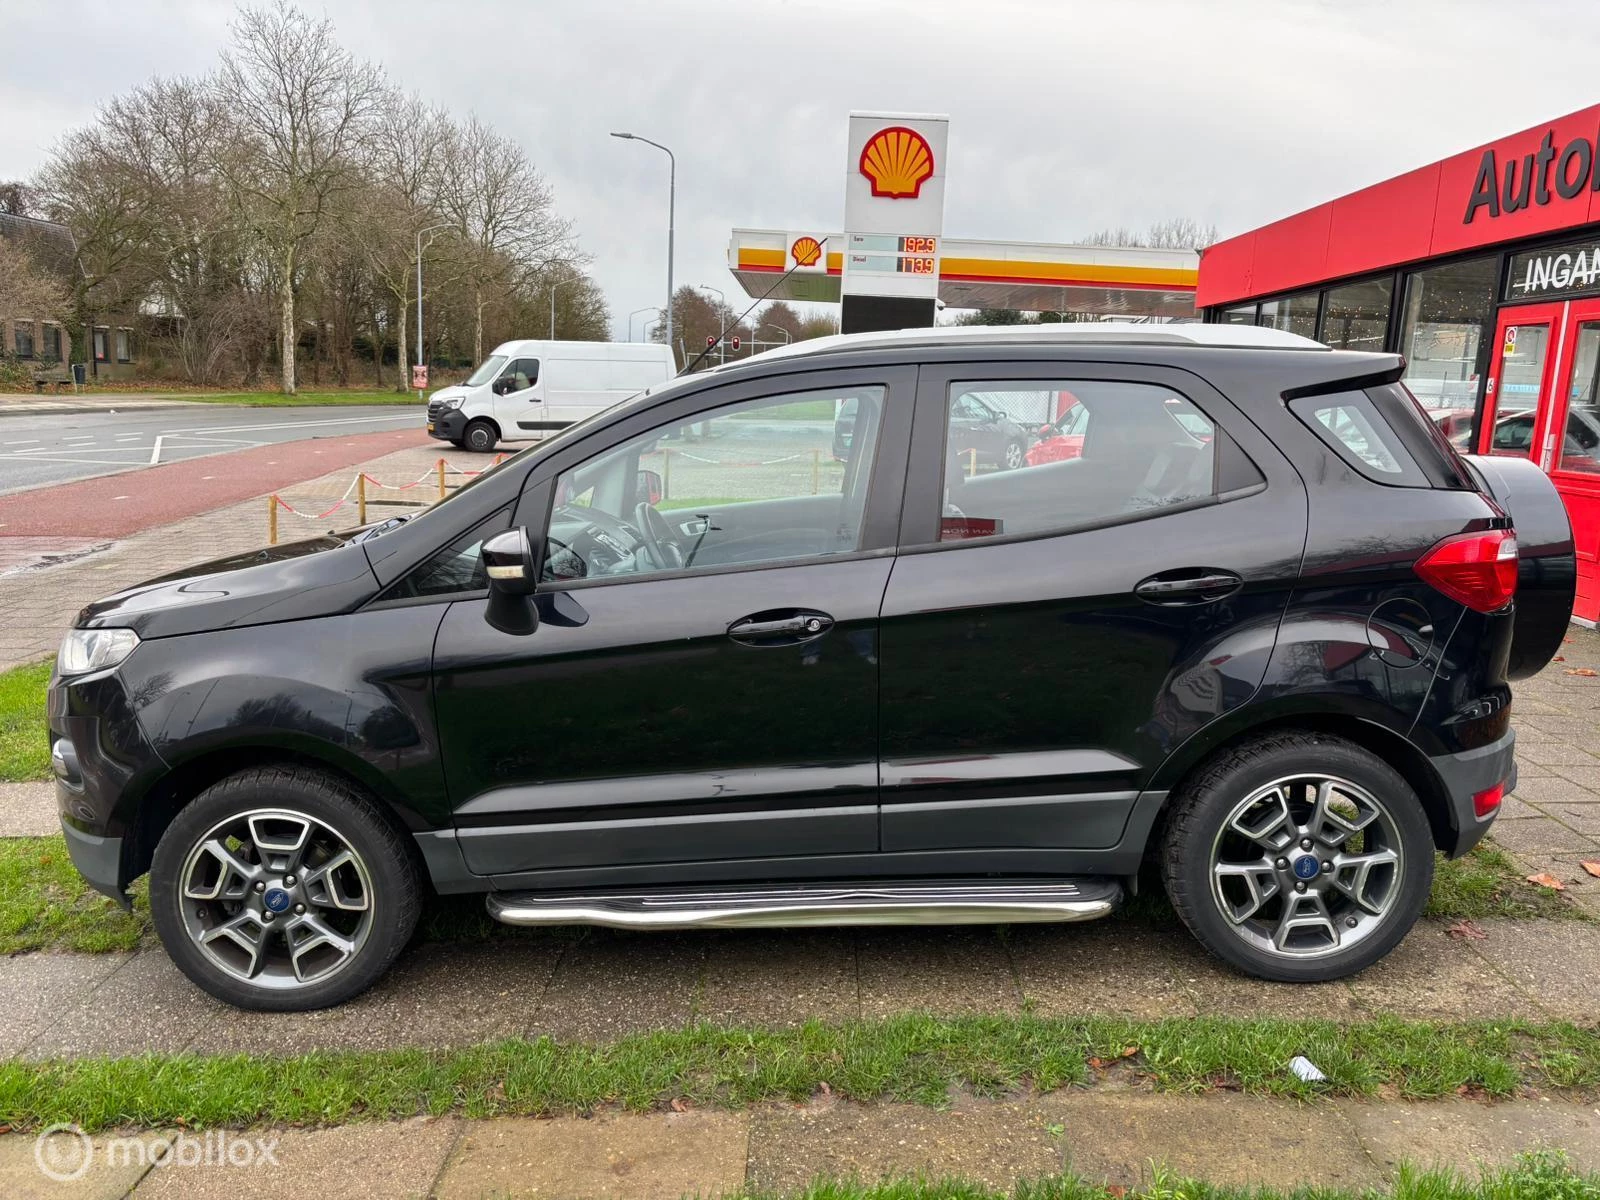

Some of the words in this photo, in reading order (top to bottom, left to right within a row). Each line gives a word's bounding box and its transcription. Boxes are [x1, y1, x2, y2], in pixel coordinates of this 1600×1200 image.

[1463, 122, 1600, 224] Auto
[904, 237, 935, 253] 192.9
[902, 257, 934, 274] 173.9
